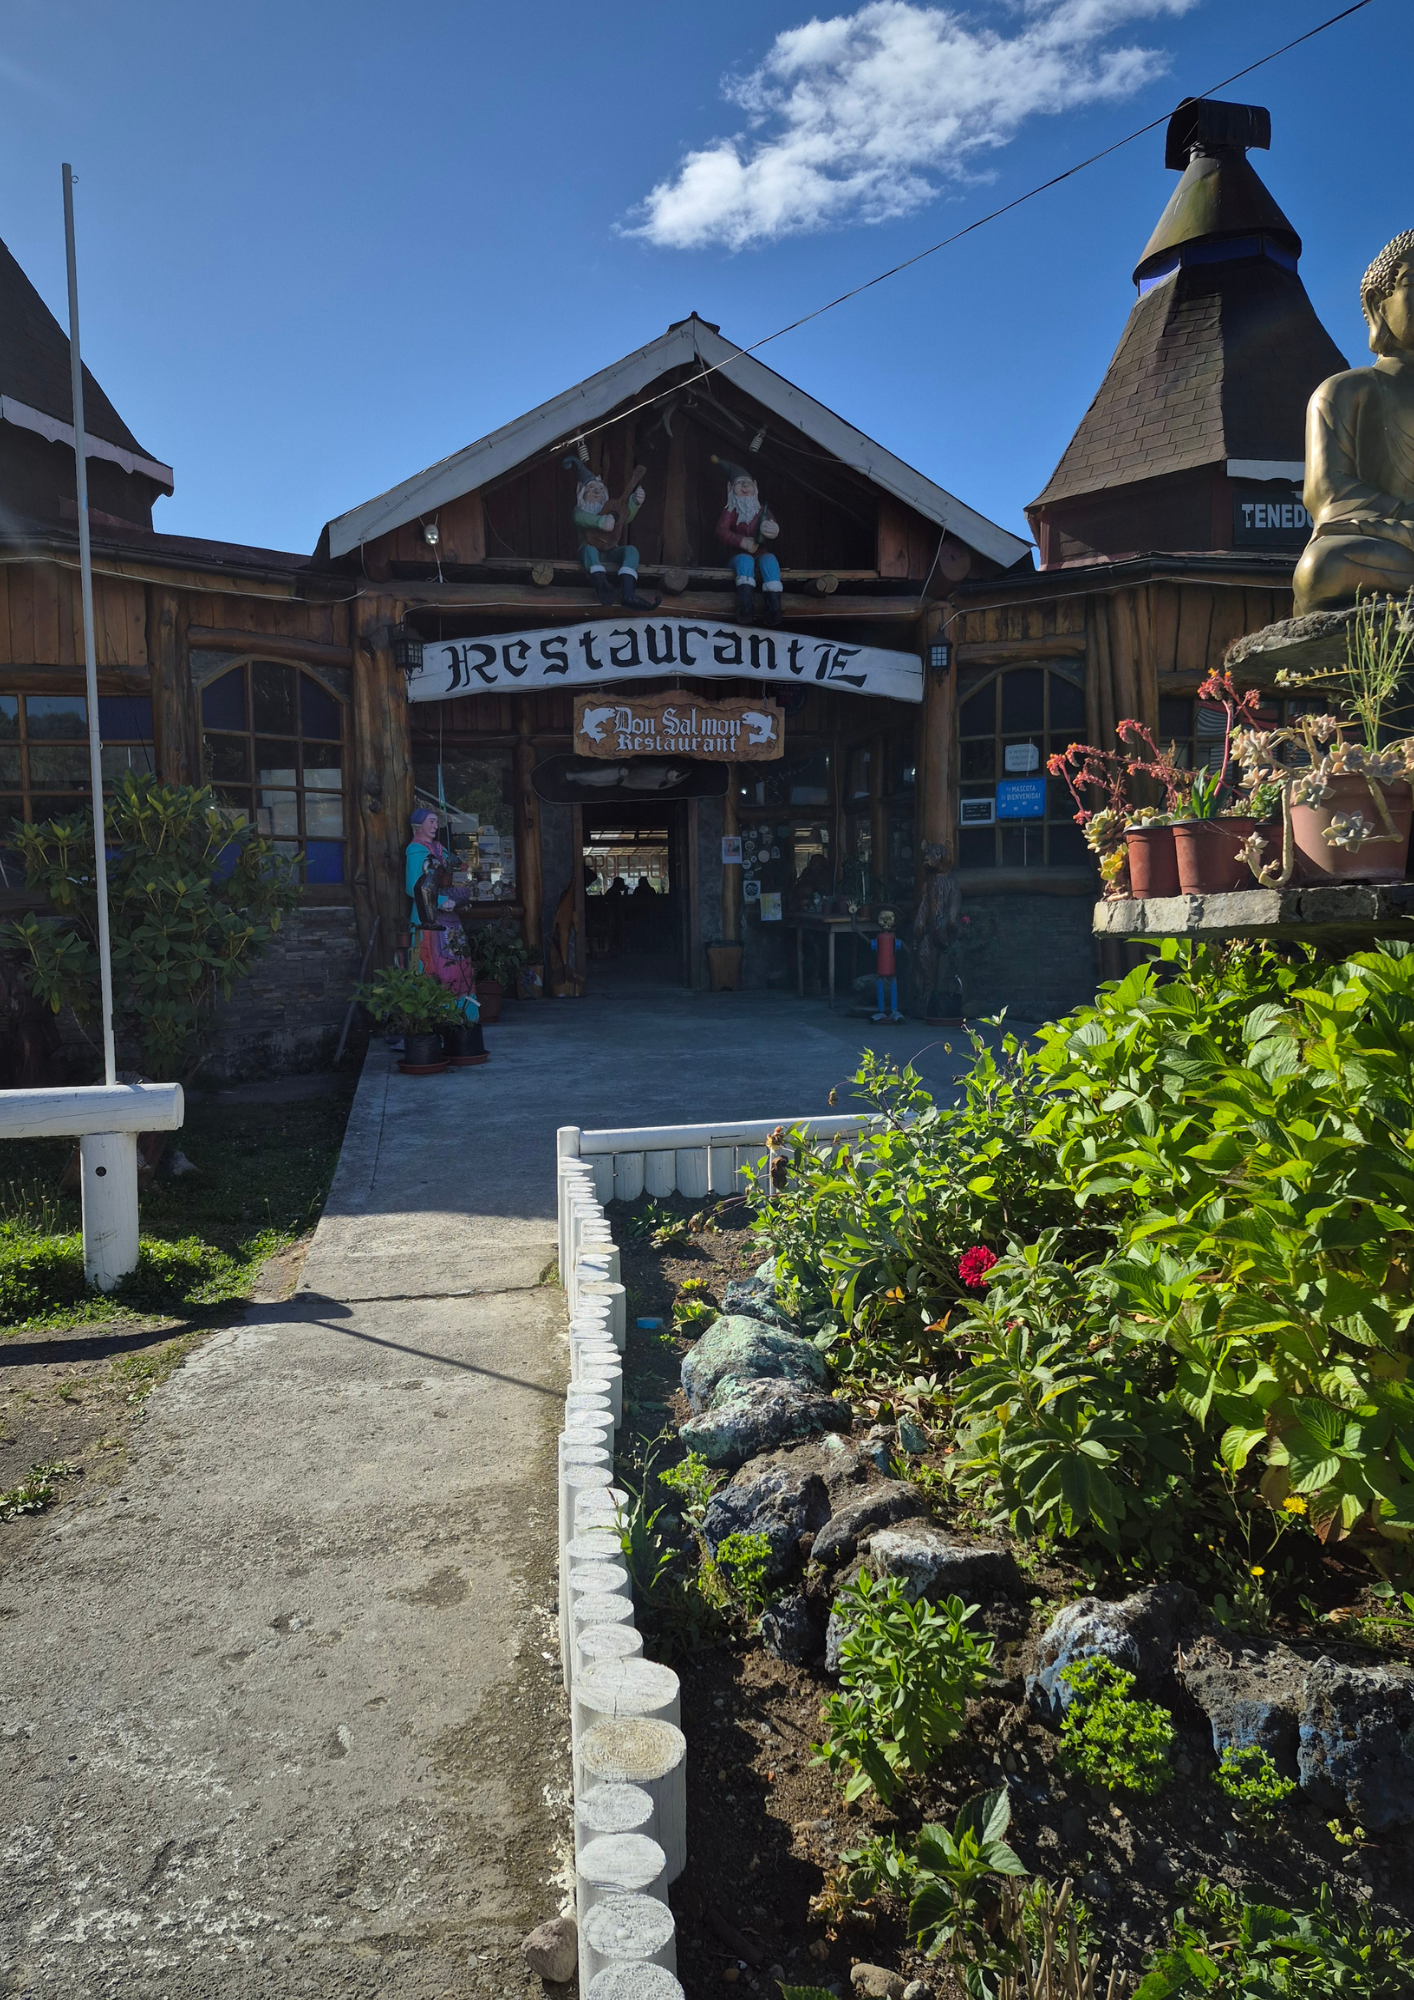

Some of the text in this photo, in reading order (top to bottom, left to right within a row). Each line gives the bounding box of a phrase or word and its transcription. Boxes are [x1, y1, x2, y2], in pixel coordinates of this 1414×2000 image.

[613, 706, 741, 736] Don Salmon
[615, 733, 738, 753] Restaurant
[1011, 785, 1036, 793] MASCOTA
